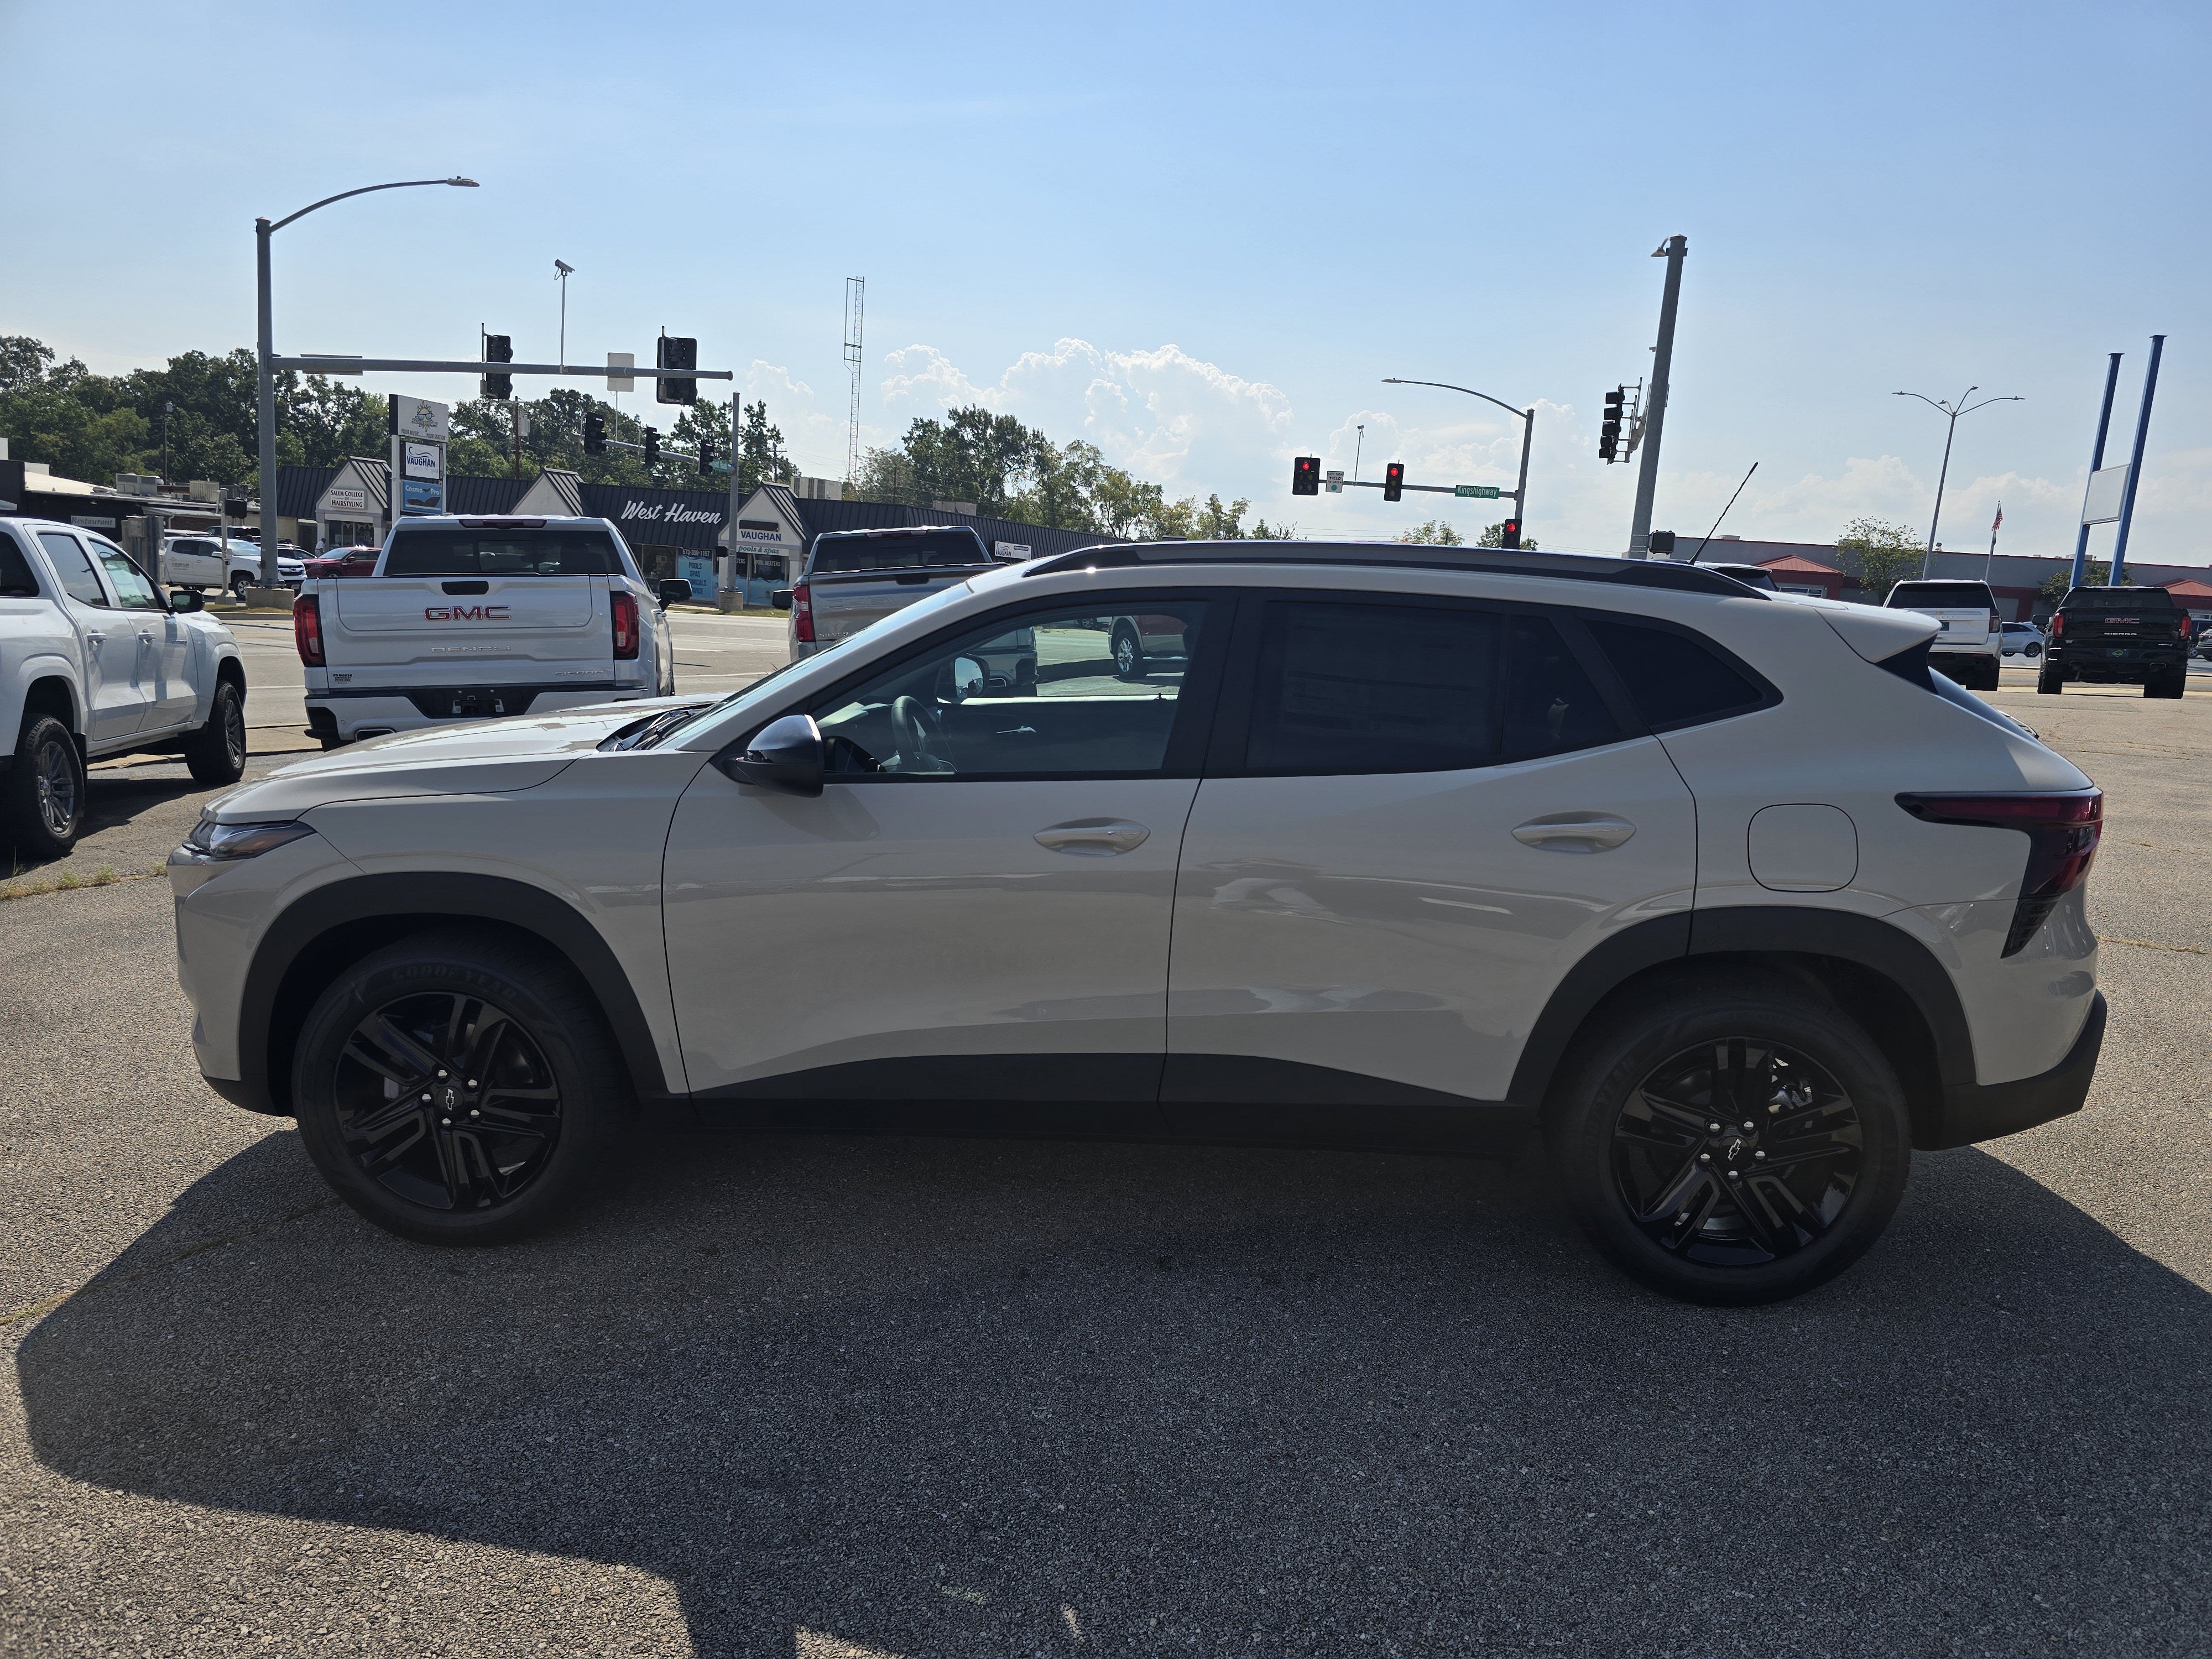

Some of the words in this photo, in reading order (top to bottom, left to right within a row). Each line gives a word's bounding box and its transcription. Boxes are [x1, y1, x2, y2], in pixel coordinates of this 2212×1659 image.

[406, 455, 435, 468] VAUGHAN
[405, 484, 423, 493] Cosmo
[1457, 485, 1498, 498] Kingshighway
[332, 499, 363, 508] HAIRSTYLING
[620, 500, 664, 520] West
[664, 503, 722, 524] Haven
[71, 517, 113, 525] Restaurant
[740, 530, 781, 541] VAUGHAN
[424, 606, 512, 622] GMC
